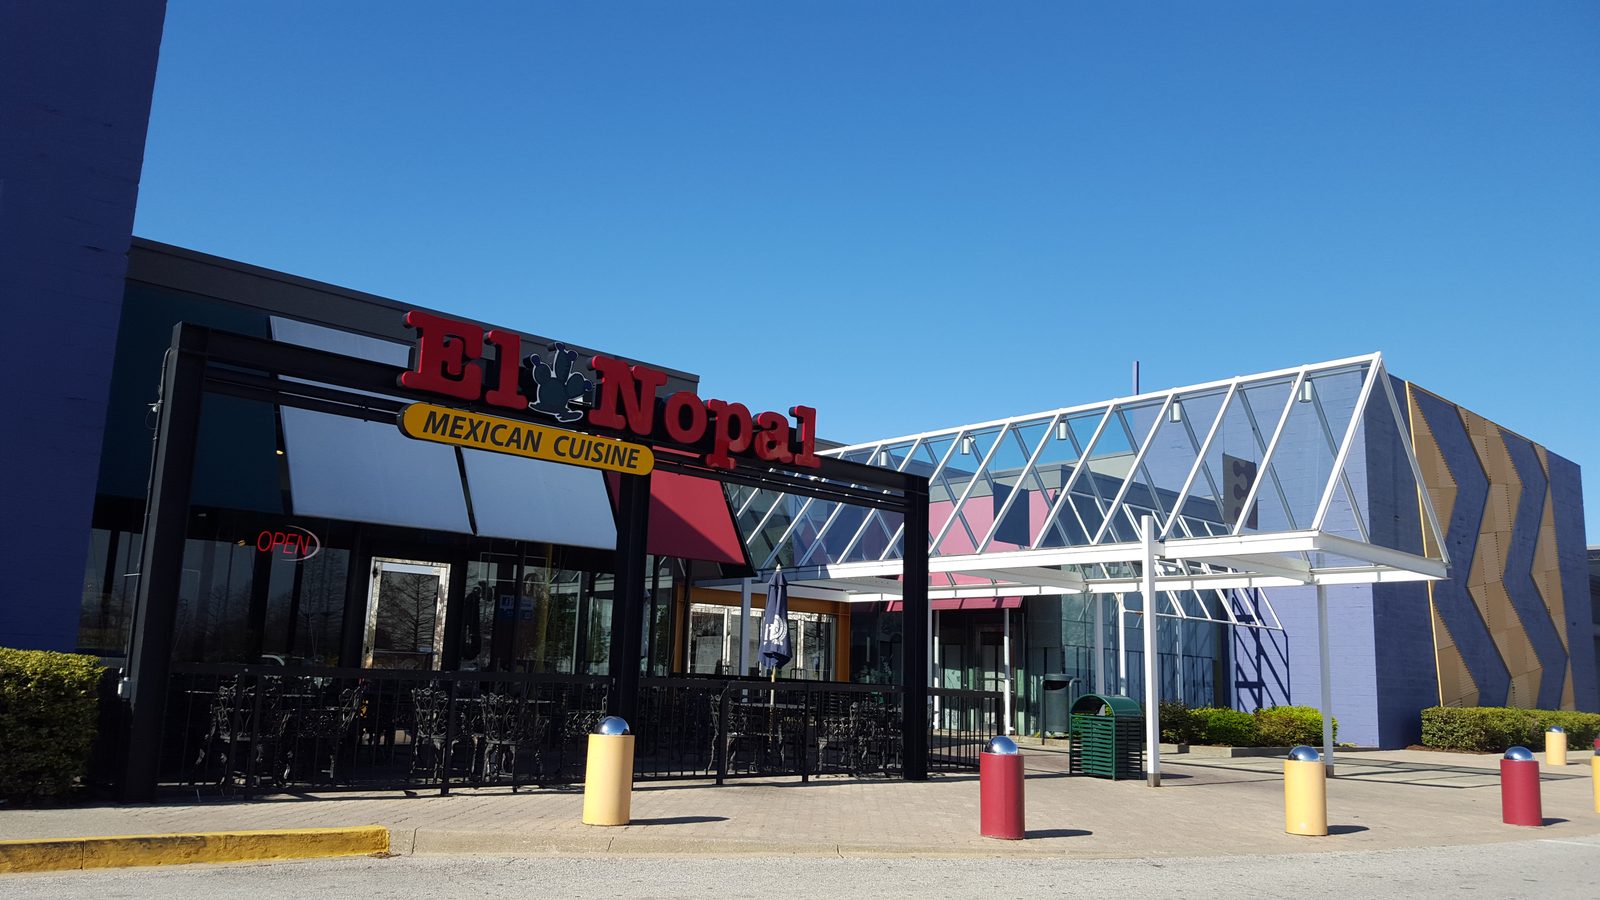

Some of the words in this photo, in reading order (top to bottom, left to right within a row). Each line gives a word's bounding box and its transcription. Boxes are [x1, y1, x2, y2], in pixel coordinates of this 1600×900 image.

[400, 310, 527, 410] El
[588, 355, 821, 469] Nopal
[423, 411, 542, 453] MEXICAN
[553, 435, 640, 469] CUISINE
[257, 530, 311, 556] OPEN
